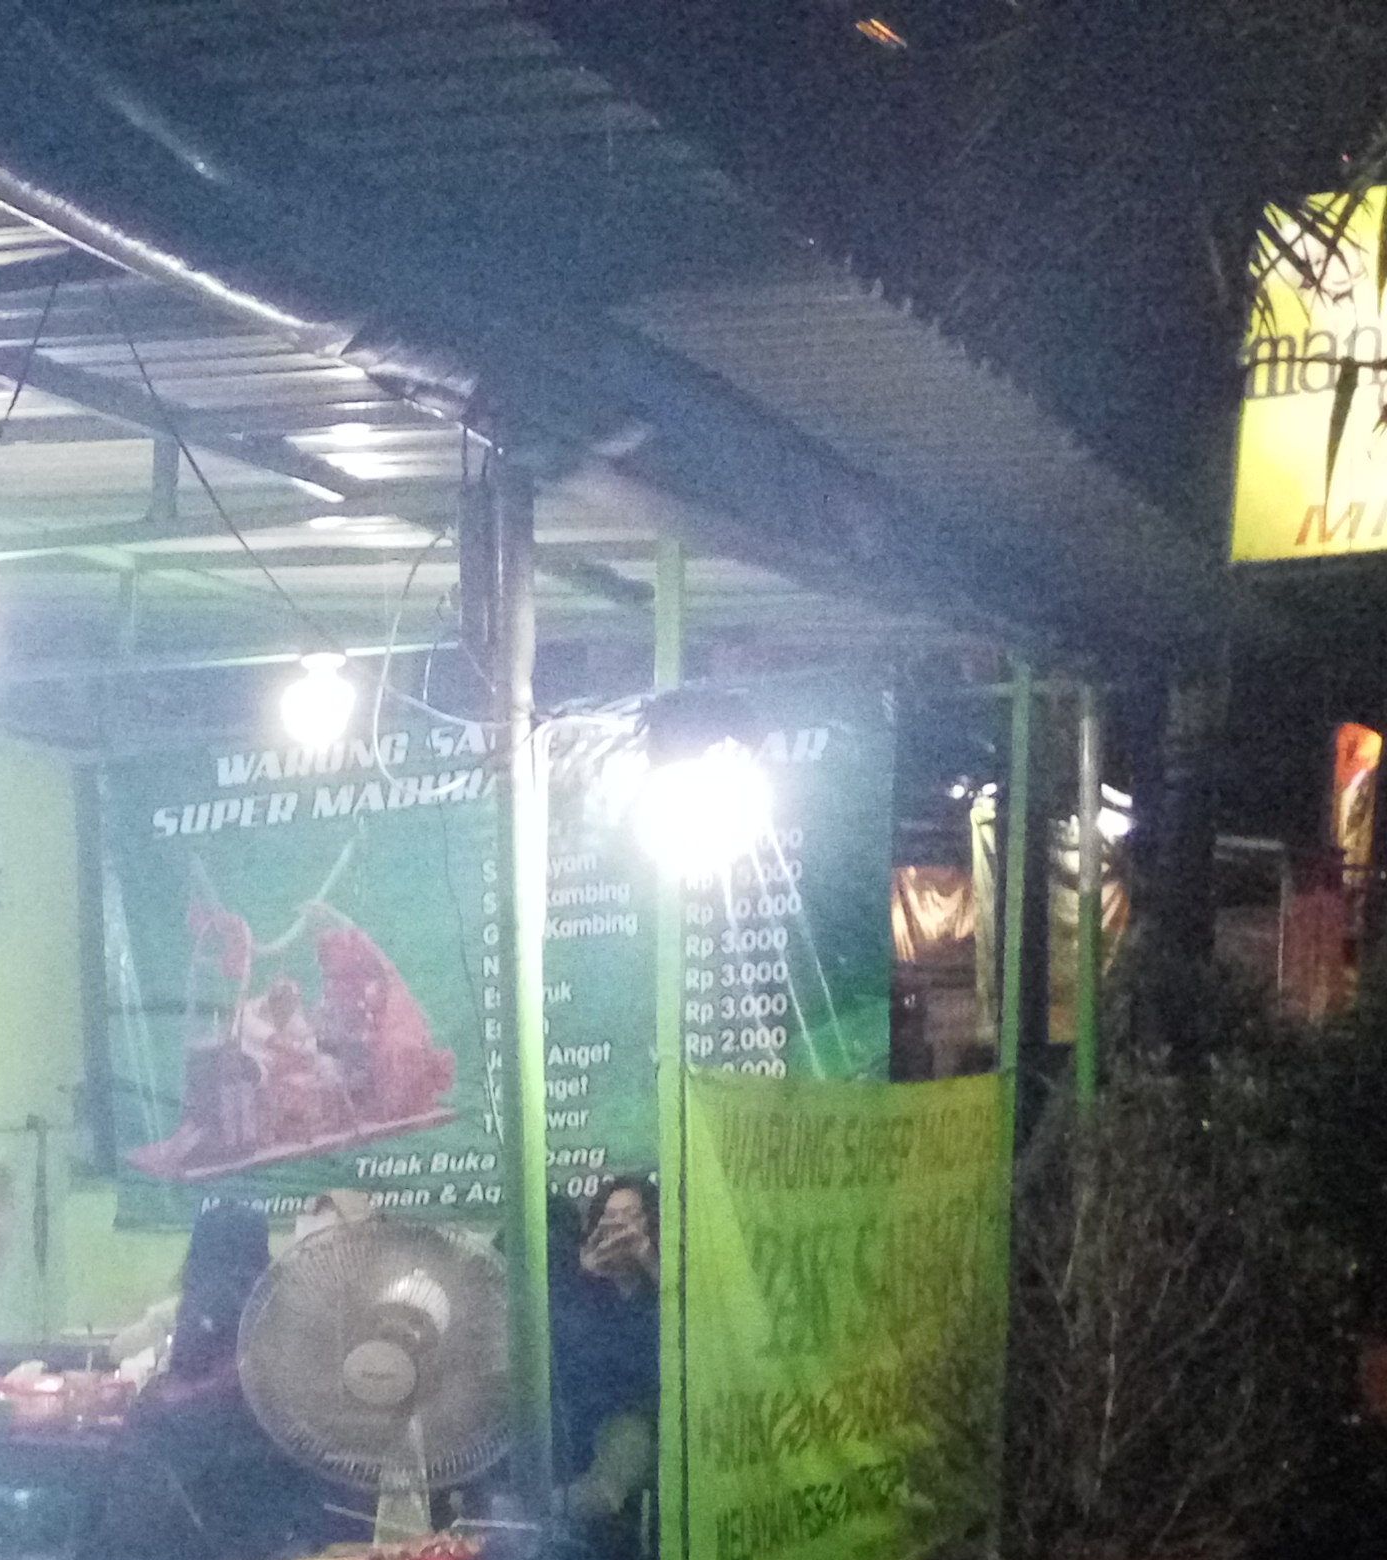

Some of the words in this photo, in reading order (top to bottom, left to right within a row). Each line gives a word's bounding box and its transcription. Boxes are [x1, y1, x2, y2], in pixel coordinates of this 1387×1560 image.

[216, 731, 409, 787] WARUNG
[152, 791, 299, 836] SUPER
[685, 904, 715, 927] Rp
[685, 936, 715, 961] Rp
[721, 925, 789, 954] 3.000
[685, 970, 715, 995] Rp
[721, 960, 789, 989] 3.000
[685, 1003, 715, 1027] Rp
[721, 993, 788, 1022] 3.000
[548, 1039, 612, 1070] Anget
[685, 1031, 715, 1057] Rp
[721, 1025, 788, 1054] 2.000
[546, 1073, 589, 1102] nget
[355, 1152, 423, 1180] Tidak
[430, 1151, 497, 1176] Buka
